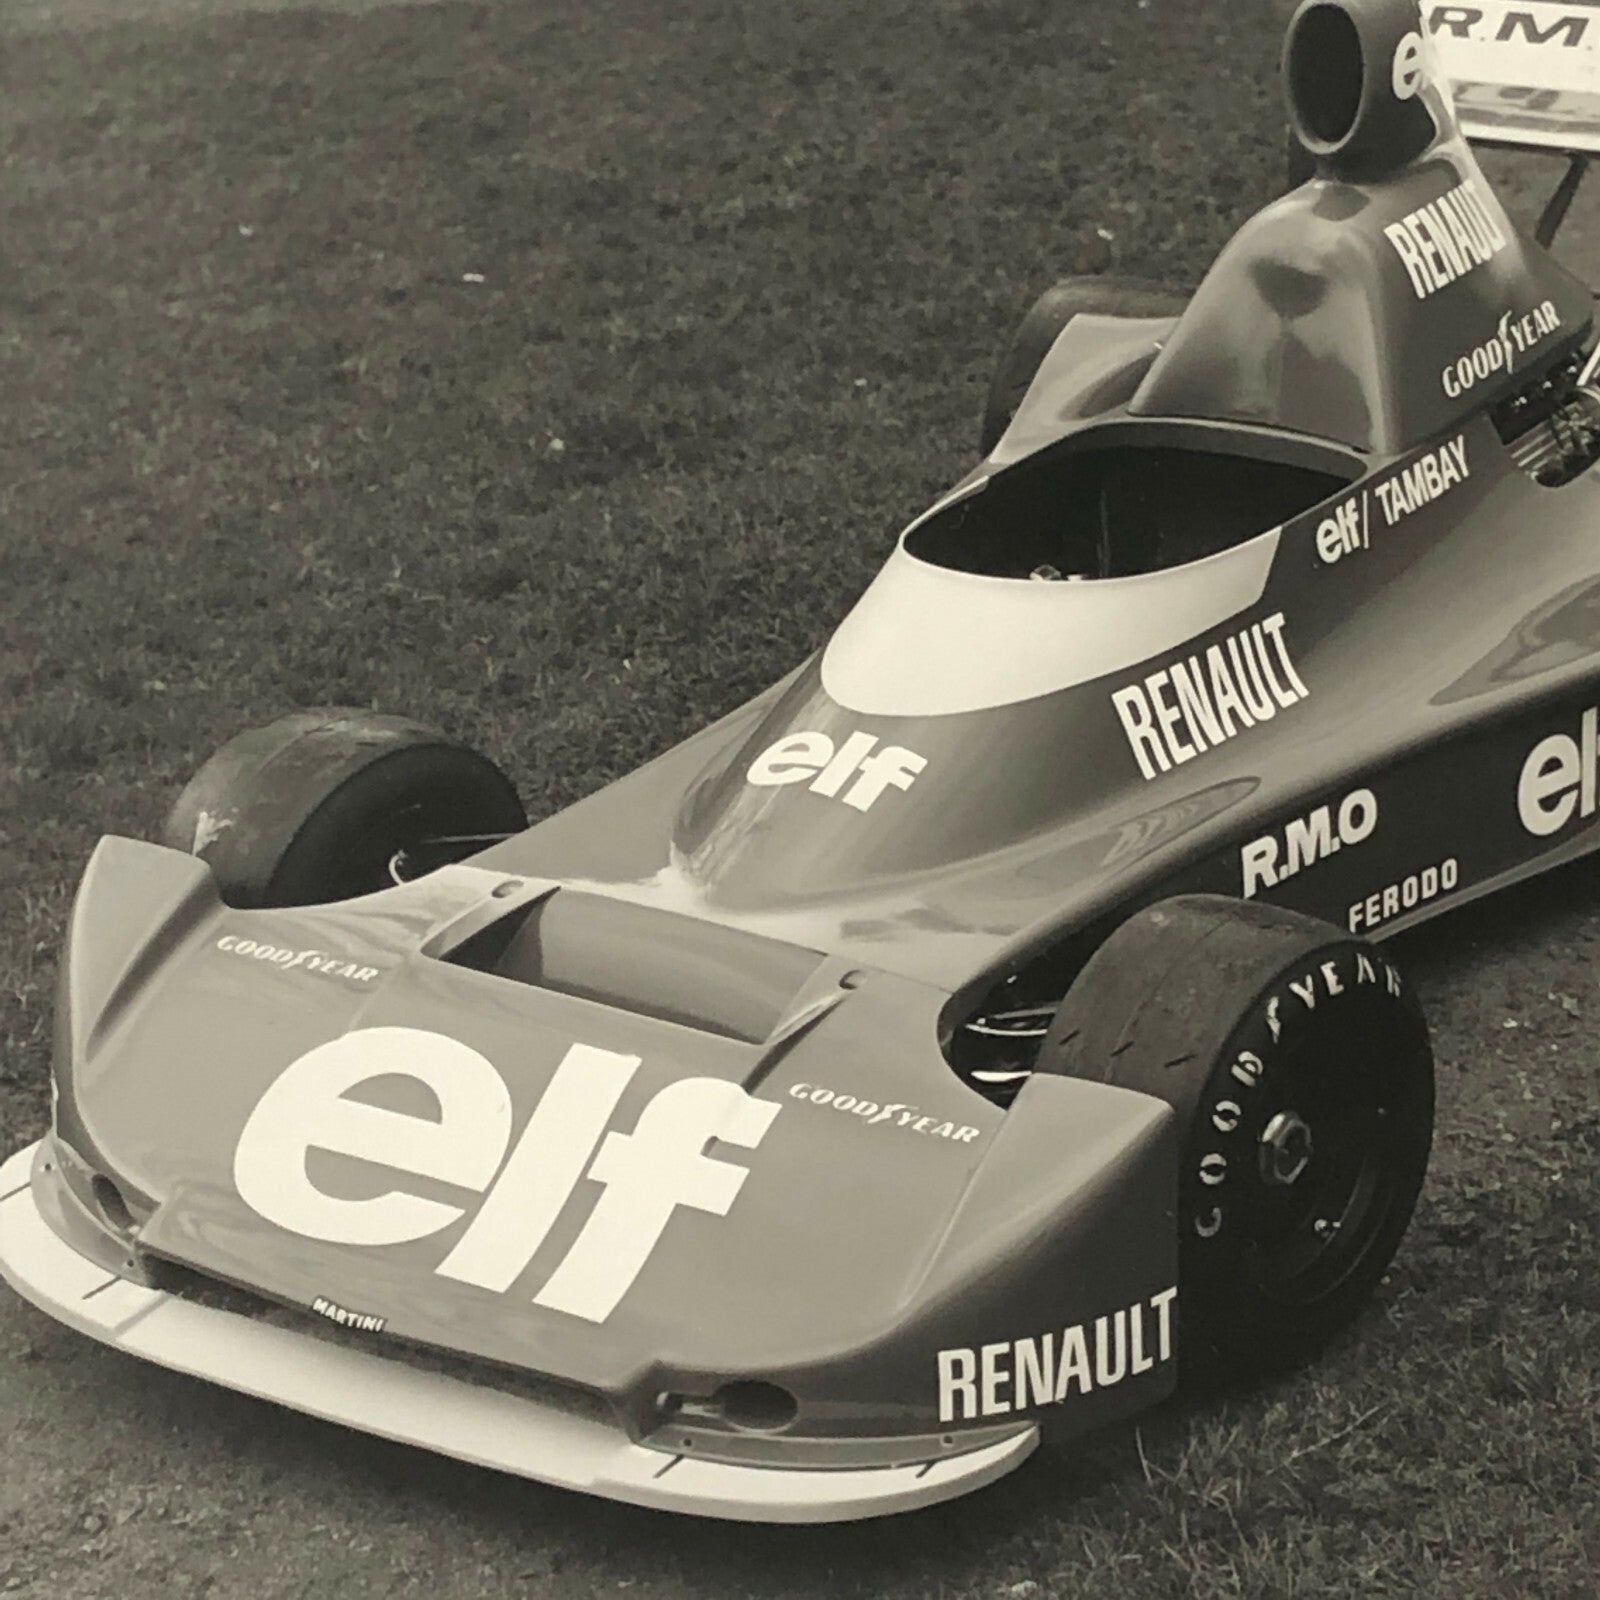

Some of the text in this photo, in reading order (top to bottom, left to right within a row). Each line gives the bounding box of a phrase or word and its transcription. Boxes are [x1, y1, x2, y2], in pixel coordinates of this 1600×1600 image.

[1383, 179, 1506, 299] RENAULT
[1442, 300, 1561, 398] GOODYEAR
[1375, 434, 1469, 526] TAMBAY
[1111, 611, 1309, 780] RENAULT
[747, 731, 928, 812] elf
[1517, 706, 1600, 836] el
[1241, 788, 1378, 899] R.M.O
[1348, 857, 1458, 933] FERODO
[217, 935, 379, 981] GOODYEAR
[789, 1083, 981, 1142] GOODYEAR
[1195, 952, 1402, 1238] GOODYEAR
[233, 1026, 783, 1323] elf
[312, 1298, 384, 1332] MARTINI
[937, 1285, 1178, 1423] RENAULT
